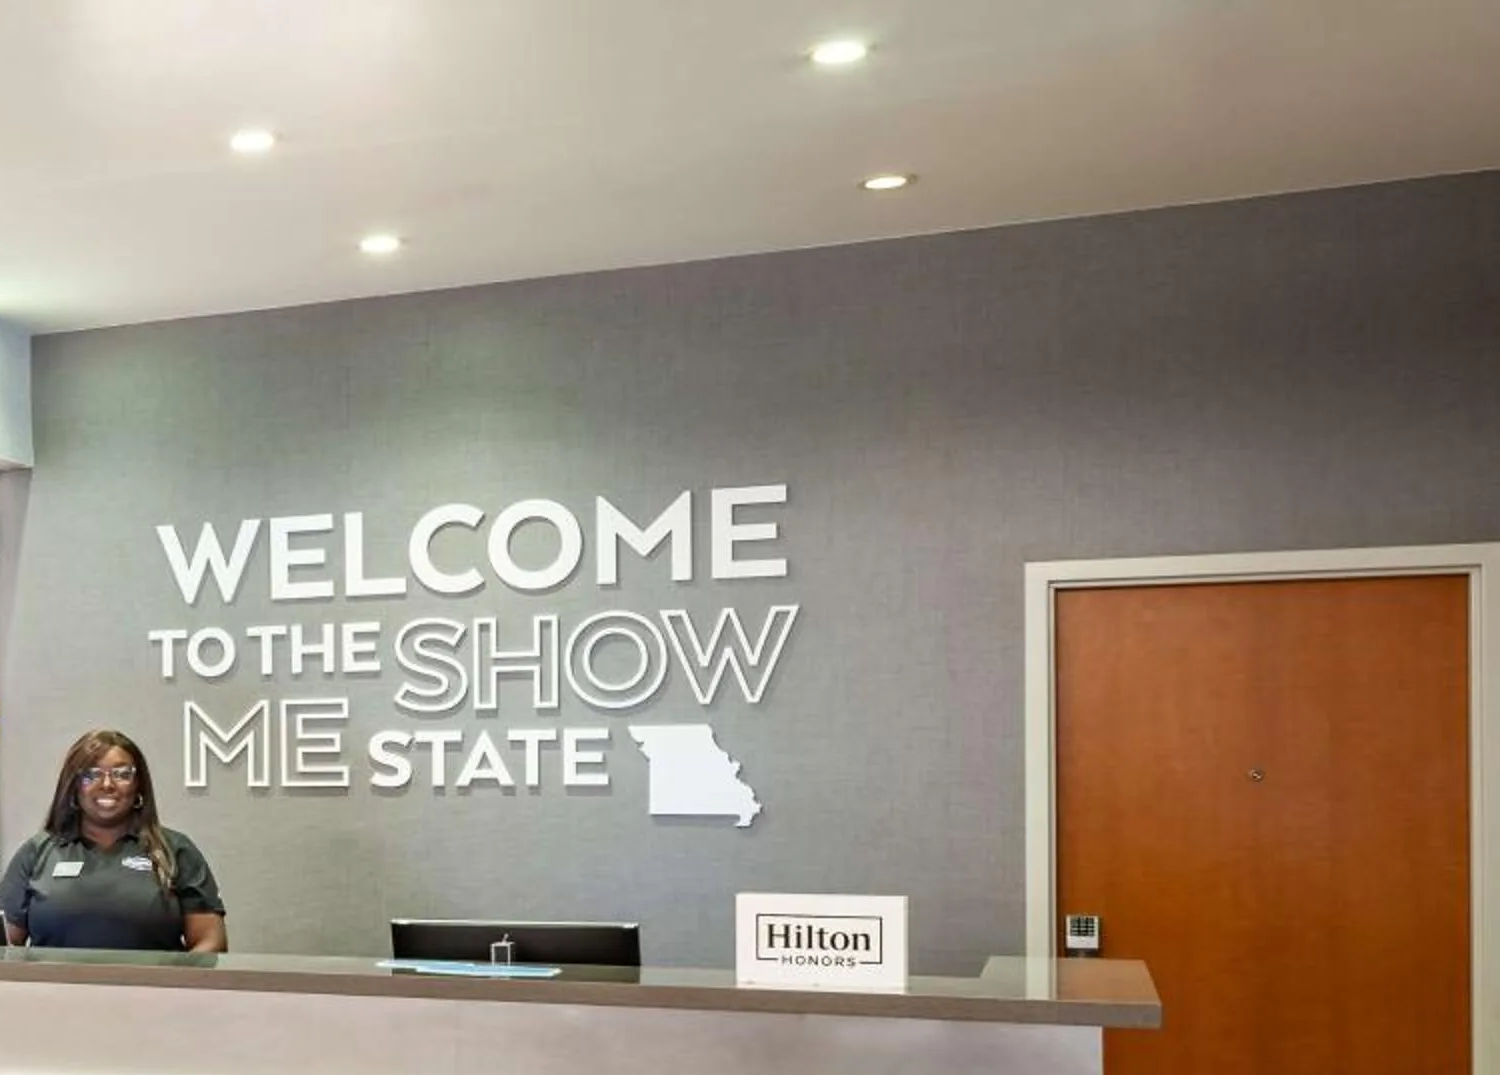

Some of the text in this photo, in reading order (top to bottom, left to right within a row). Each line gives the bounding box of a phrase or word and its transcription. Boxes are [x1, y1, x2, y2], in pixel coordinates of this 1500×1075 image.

[155, 484, 789, 604] WELCOME
[149, 604, 800, 713] TO THE SHOW
[183, 697, 611, 789] ME STATE
[767, 923, 871, 951] Hilton
[781, 955, 857, 967] HONORS
